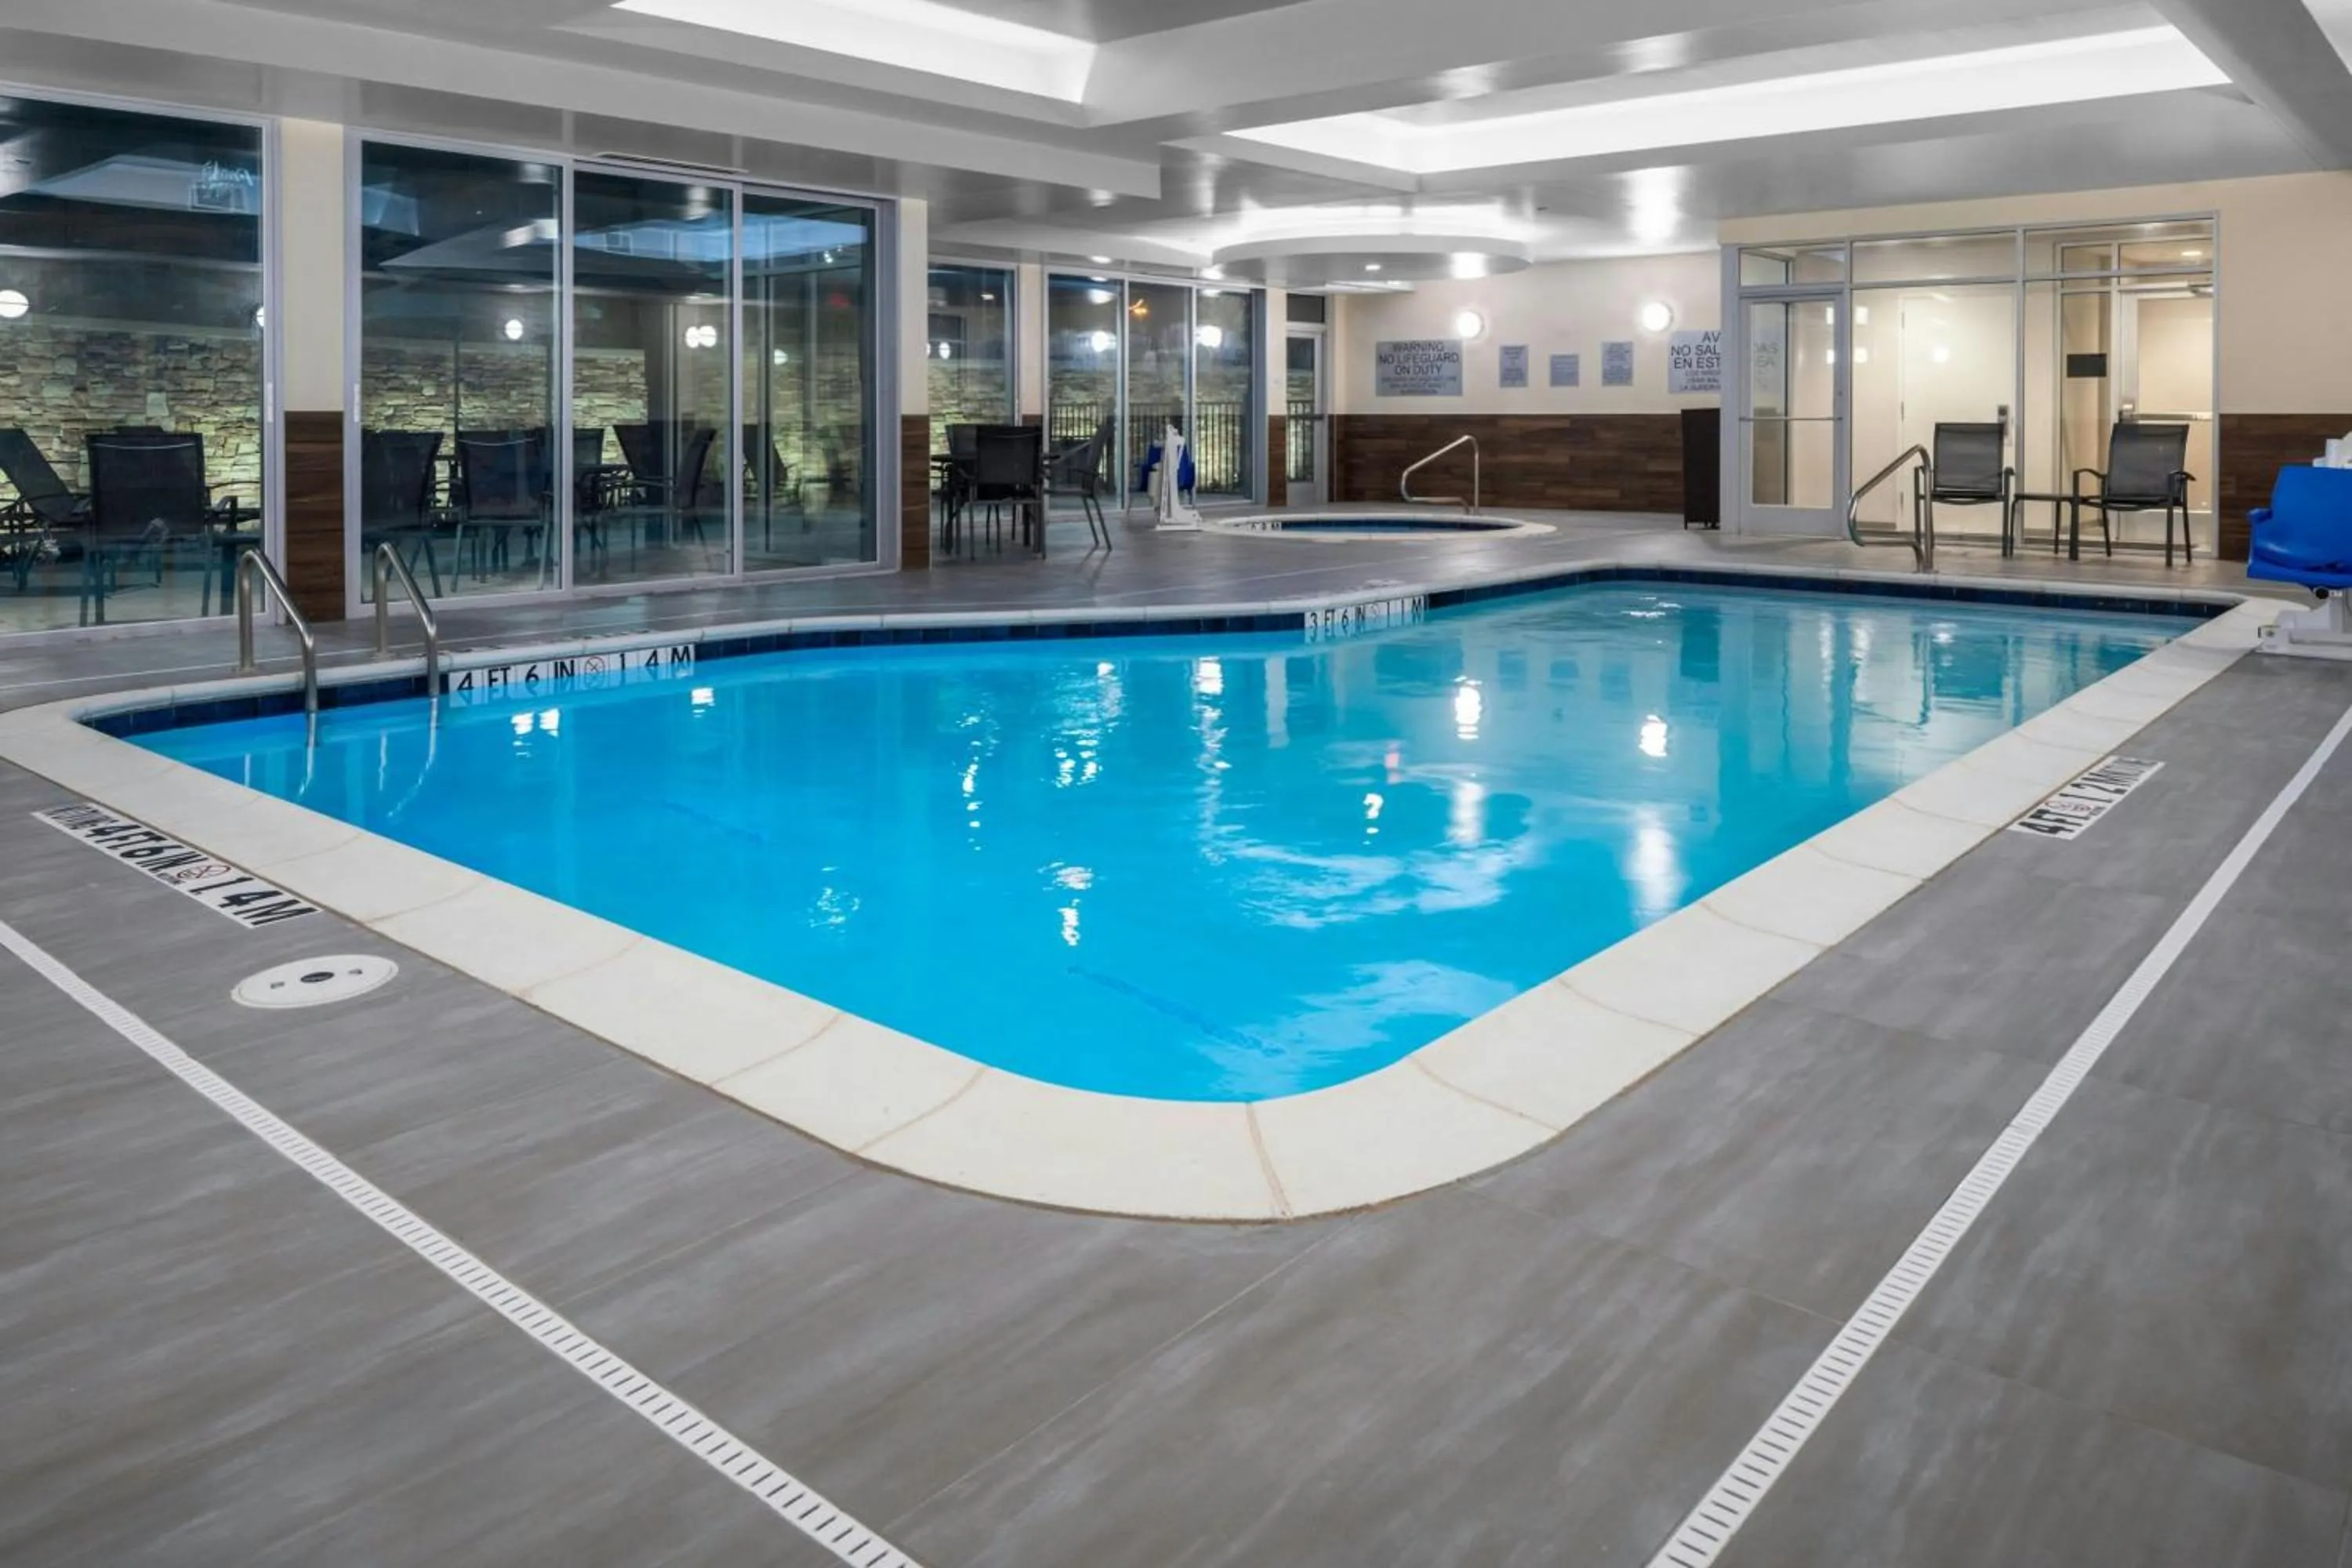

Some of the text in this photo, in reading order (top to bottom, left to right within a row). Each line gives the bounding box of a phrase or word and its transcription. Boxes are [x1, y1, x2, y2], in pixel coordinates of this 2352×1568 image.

[1393, 342, 1444, 351] WARNING
[1671, 344, 1691, 356] NO
[1379, 352, 1460, 364] NO LIFEGUARD
[1674, 357, 1692, 368] EN
[1395, 363, 1443, 375] ON DUTY
[457, 673, 474, 691] 4
[488, 666, 511, 688] FT
[525, 664, 539, 684] 6
[554, 659, 575, 679] IN
[670, 645, 691, 664] M
[2027, 808, 2091, 826] FT
[84, 824, 142, 838] 4
[2018, 822, 2075, 835] 4
[94, 830, 169, 849] FT
[119, 844, 184, 858] 6
[135, 851, 209, 873] IN
[233, 898, 318, 926] M
